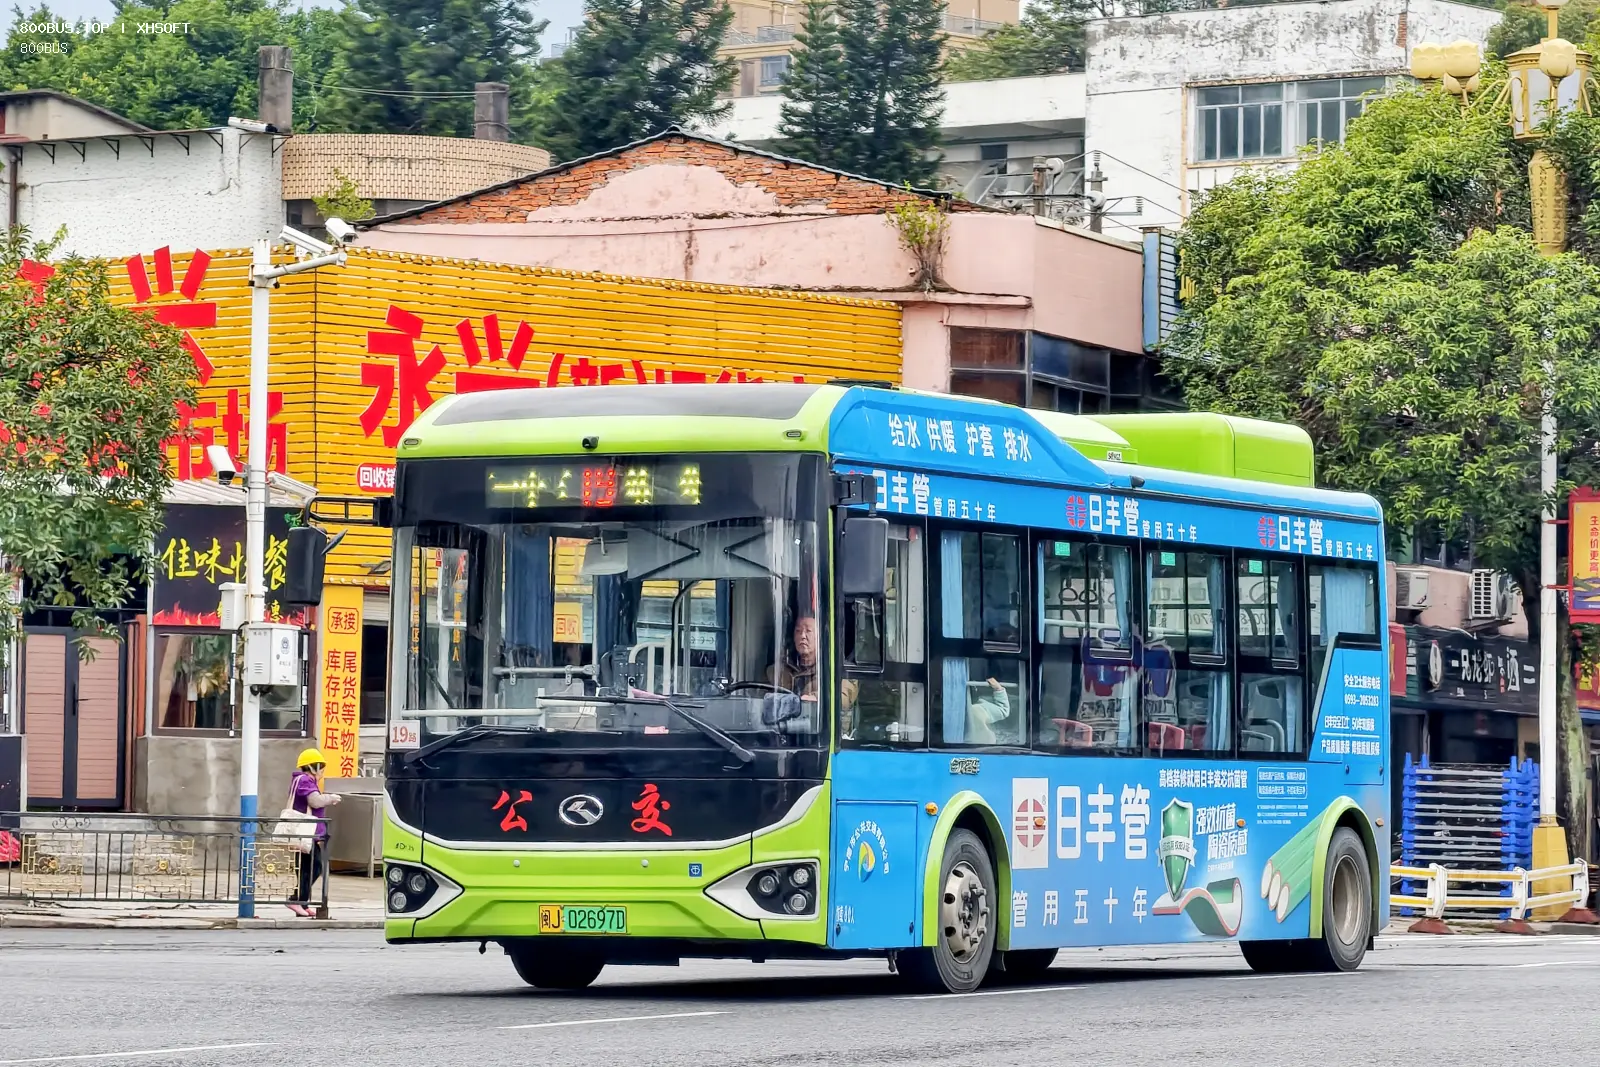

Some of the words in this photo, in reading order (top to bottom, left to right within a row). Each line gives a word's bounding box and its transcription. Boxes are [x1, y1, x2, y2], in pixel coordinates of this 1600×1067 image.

[888, 411, 922, 449] 给水
[926, 417, 958, 455] 供暖
[965, 421, 996, 459] 护套
[1003, 426, 1033, 462] 排水
[933, 496, 997, 523] 管用五十年
[1088, 493, 1140, 538] 日丰管
[1142, 519, 1198, 544] 管用五十年
[1278, 515, 1323, 556] 日丰管
[1325, 538, 1374, 562] 管用五十年
[330, 611, 357, 632] 承接
[323, 648, 342, 751] 库存积压
[339, 650, 358, 778] 尾货等物资
[491, 789, 533, 832] 公
[630, 783, 673, 837] 交
[1056, 783, 1151, 862] 日丰管
[1195, 802, 1237, 836] 强效抗菌
[1207, 828, 1249, 861] 陶瓷质感
[1012, 886, 1149, 929] 管用五十年
